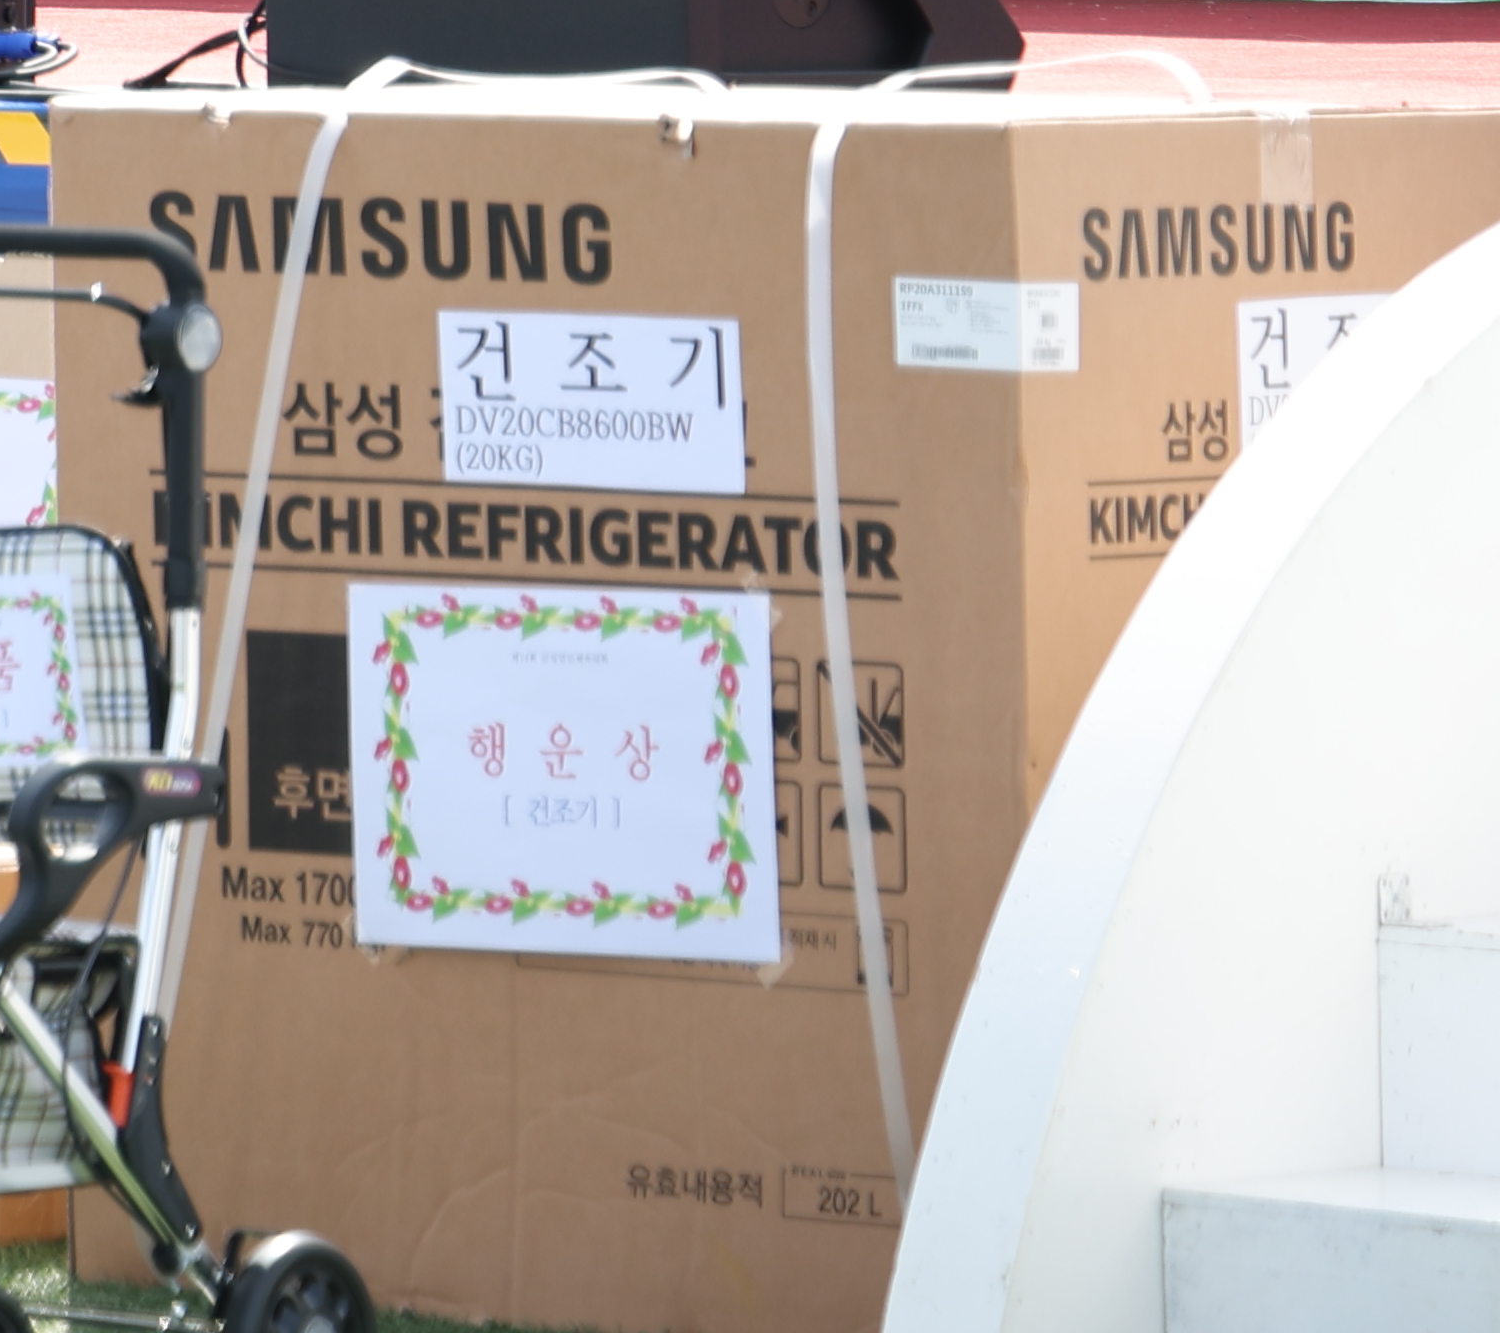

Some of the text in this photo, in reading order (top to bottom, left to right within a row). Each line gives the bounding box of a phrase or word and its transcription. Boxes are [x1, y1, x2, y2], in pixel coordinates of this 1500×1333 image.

[149, 190, 614, 285] SAMSUNG
[1082, 201, 1356, 283] SAMSUNG
[282, 381, 404, 462] 삼성
[455, 405, 694, 443] DV20CB8600BW
[1162, 398, 1230, 463] 삼성
[456, 442, 545, 477] (20KG)
[402, 499, 900, 581] REFRIGERATOR
[273, 764, 351, 821] 후면
[222, 866, 286, 903] Max
[240, 916, 292, 946] Max
[302, 920, 344, 949] 770
[628, 1163, 764, 1210] 유효내용적
[818, 1185, 883, 1217] 202 L
